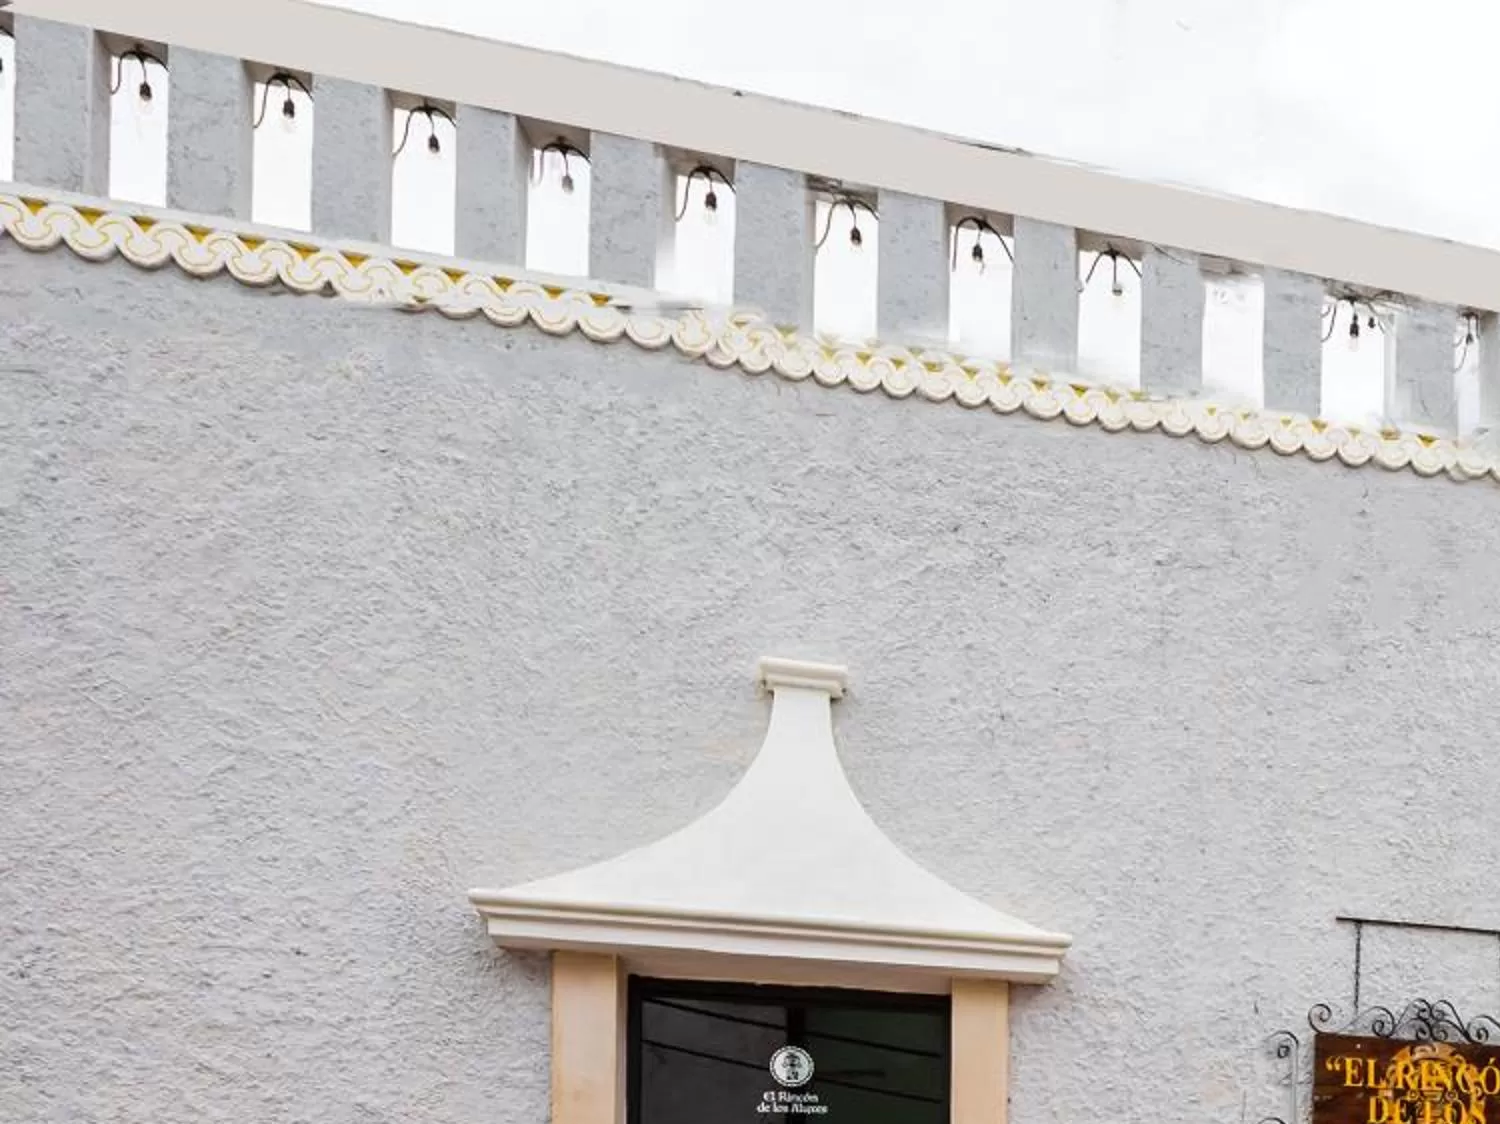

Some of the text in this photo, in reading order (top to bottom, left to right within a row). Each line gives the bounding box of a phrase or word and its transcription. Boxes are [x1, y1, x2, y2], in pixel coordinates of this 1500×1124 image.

[763, 1090, 776, 1102] El
[757, 1101, 771, 1113] de
[772, 1101, 789, 1113] los
